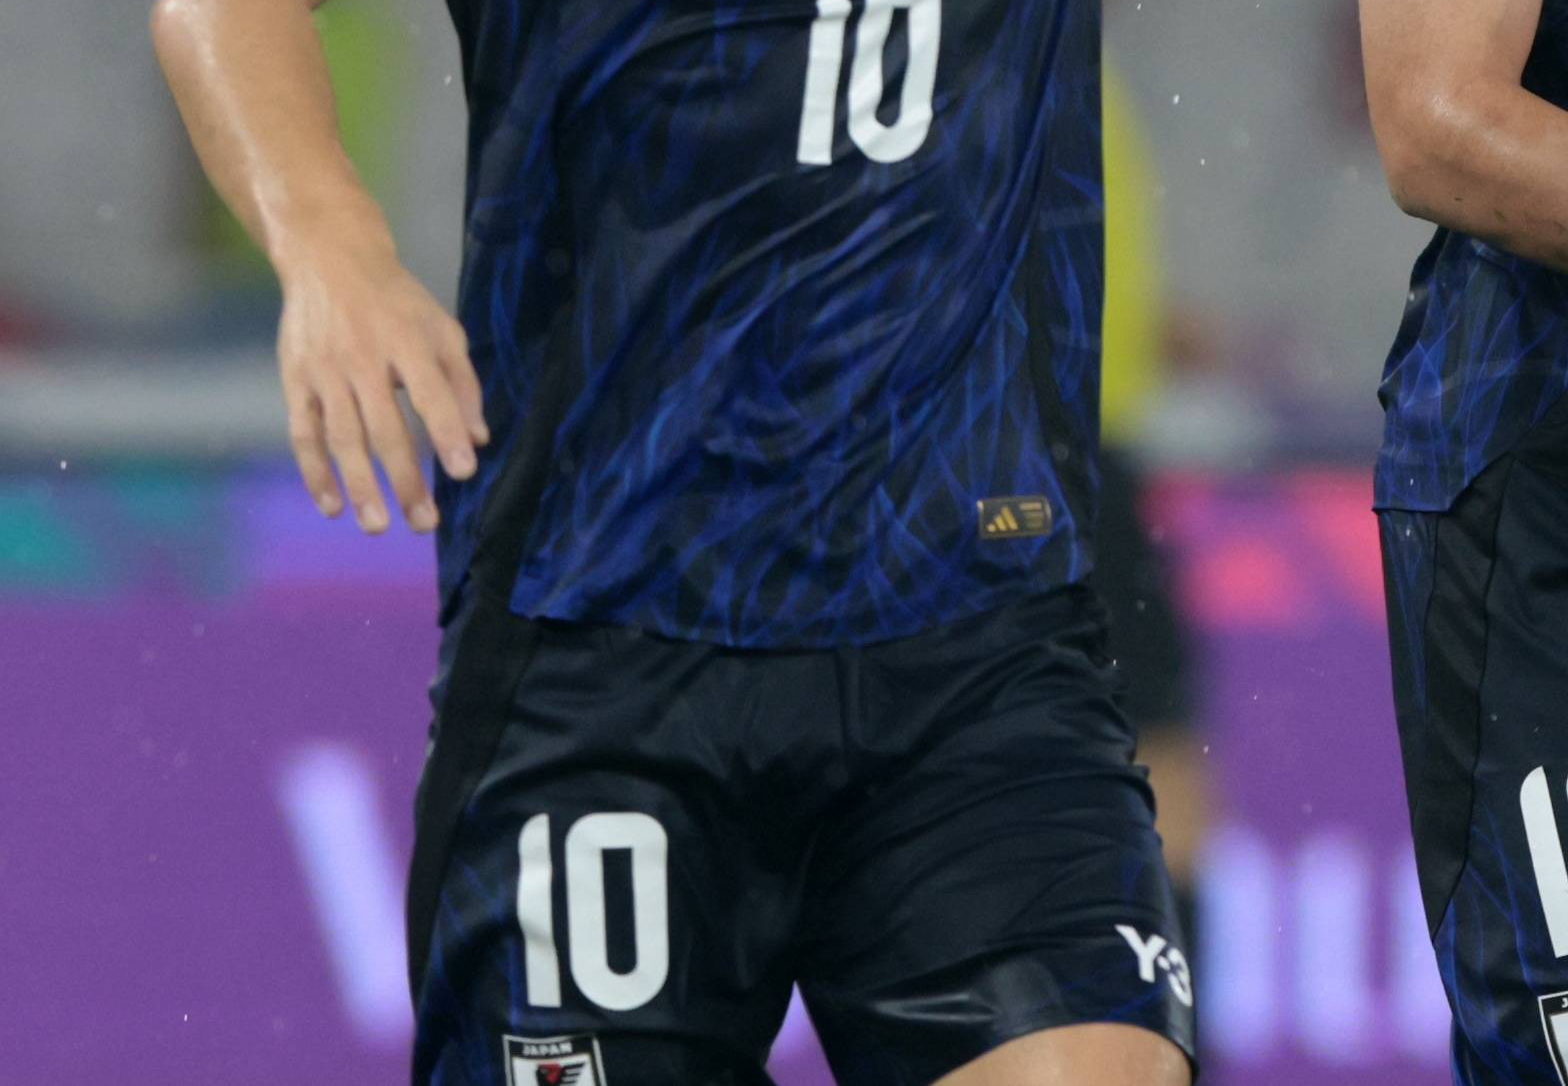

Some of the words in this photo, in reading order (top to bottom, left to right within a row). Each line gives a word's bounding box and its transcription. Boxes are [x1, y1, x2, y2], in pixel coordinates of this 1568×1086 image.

[517, 812, 669, 1011] 10
[1114, 924, 1193, 1007] Y-3
[523, 1042, 573, 1056] JAPAN
